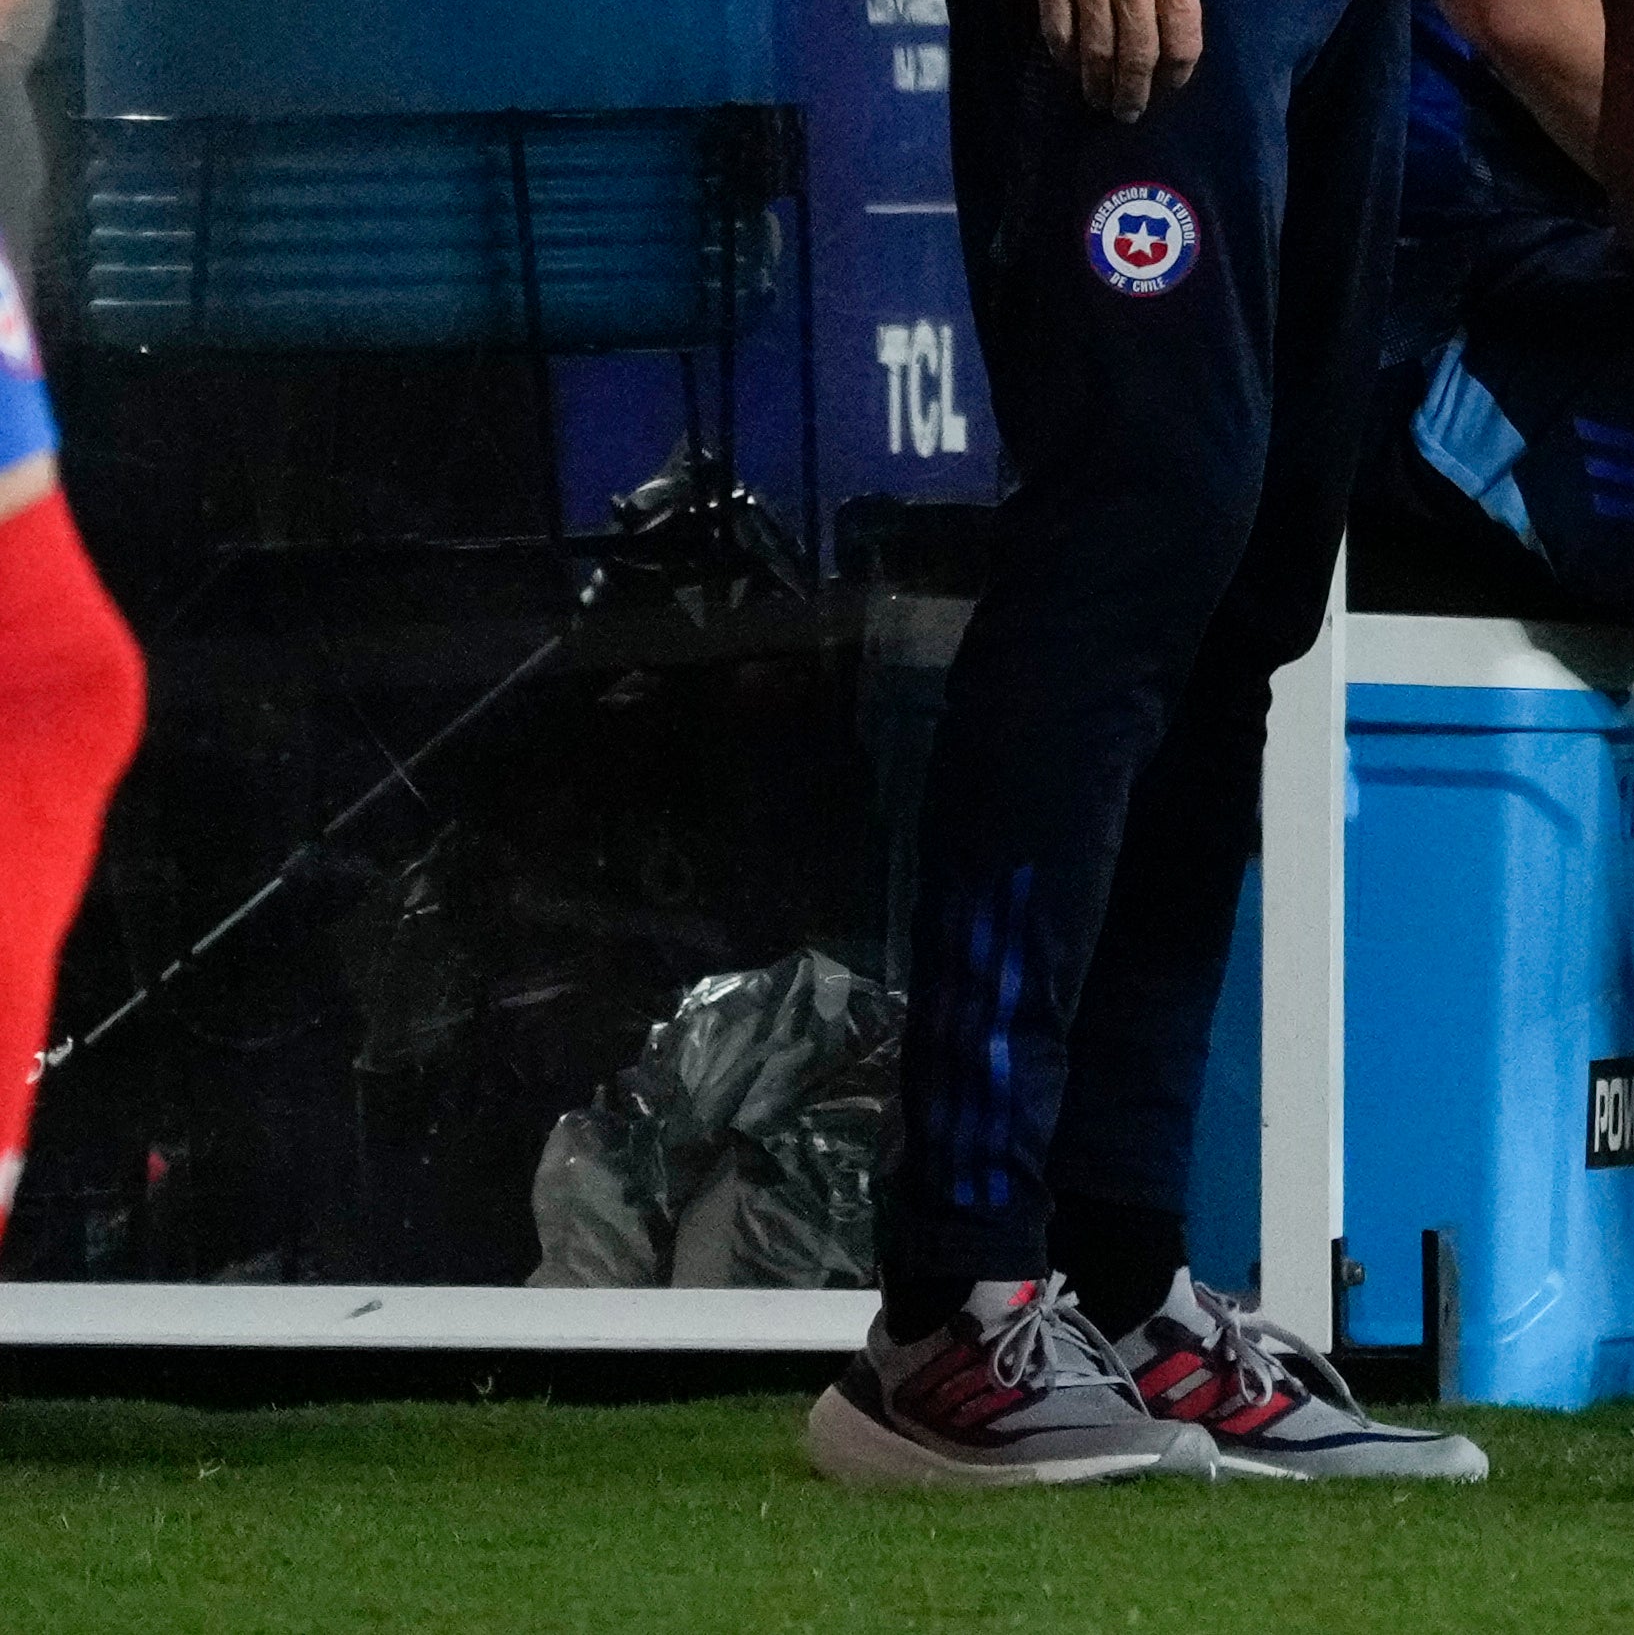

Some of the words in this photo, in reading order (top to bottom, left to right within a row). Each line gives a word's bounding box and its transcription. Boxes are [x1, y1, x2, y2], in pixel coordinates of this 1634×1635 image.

[1089, 187, 1149, 234] FEDERACION
[1156, 190, 1173, 206] DE
[1172, 202, 1196, 246] FUTBOL
[1109, 272, 1128, 288] DE
[1132, 277, 1166, 293] CHILE
[876, 319, 967, 458] TCL
